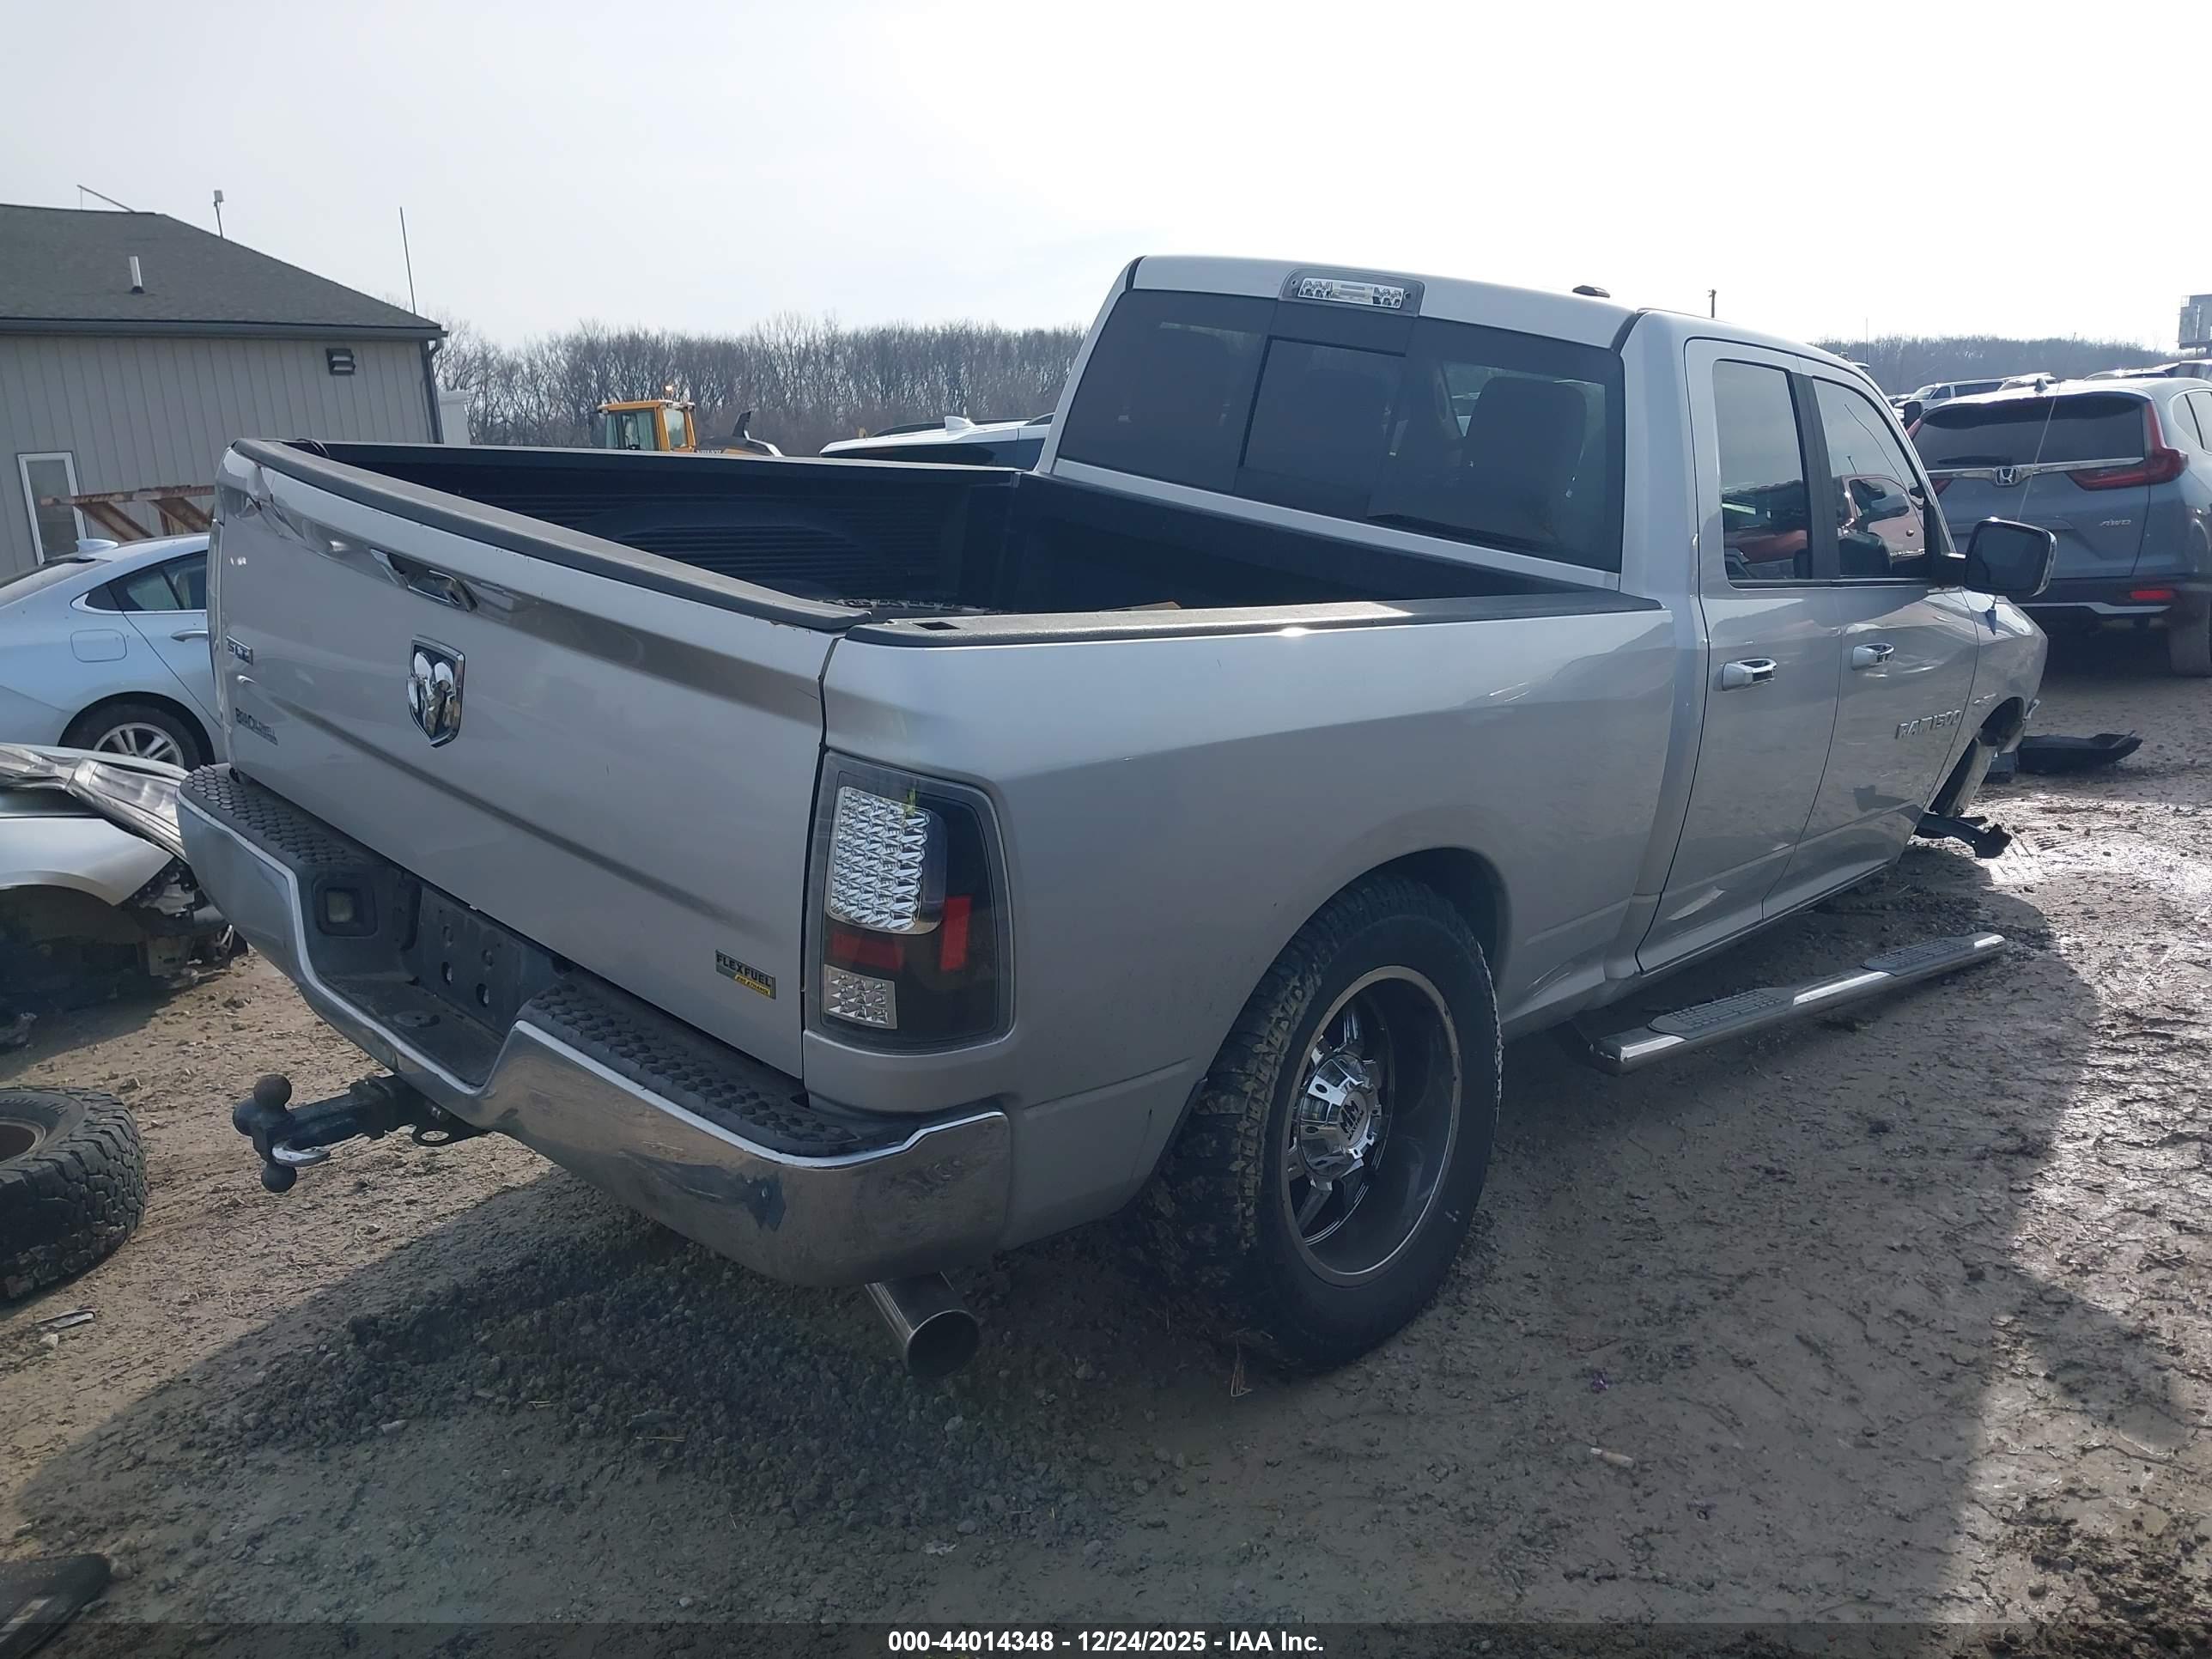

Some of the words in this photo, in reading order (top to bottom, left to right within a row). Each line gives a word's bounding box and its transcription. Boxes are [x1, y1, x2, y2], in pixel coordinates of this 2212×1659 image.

[227, 641, 249, 660] SLT
[1895, 716, 1932, 740] RAM
[716, 953, 771, 987] FLEXFUEL
